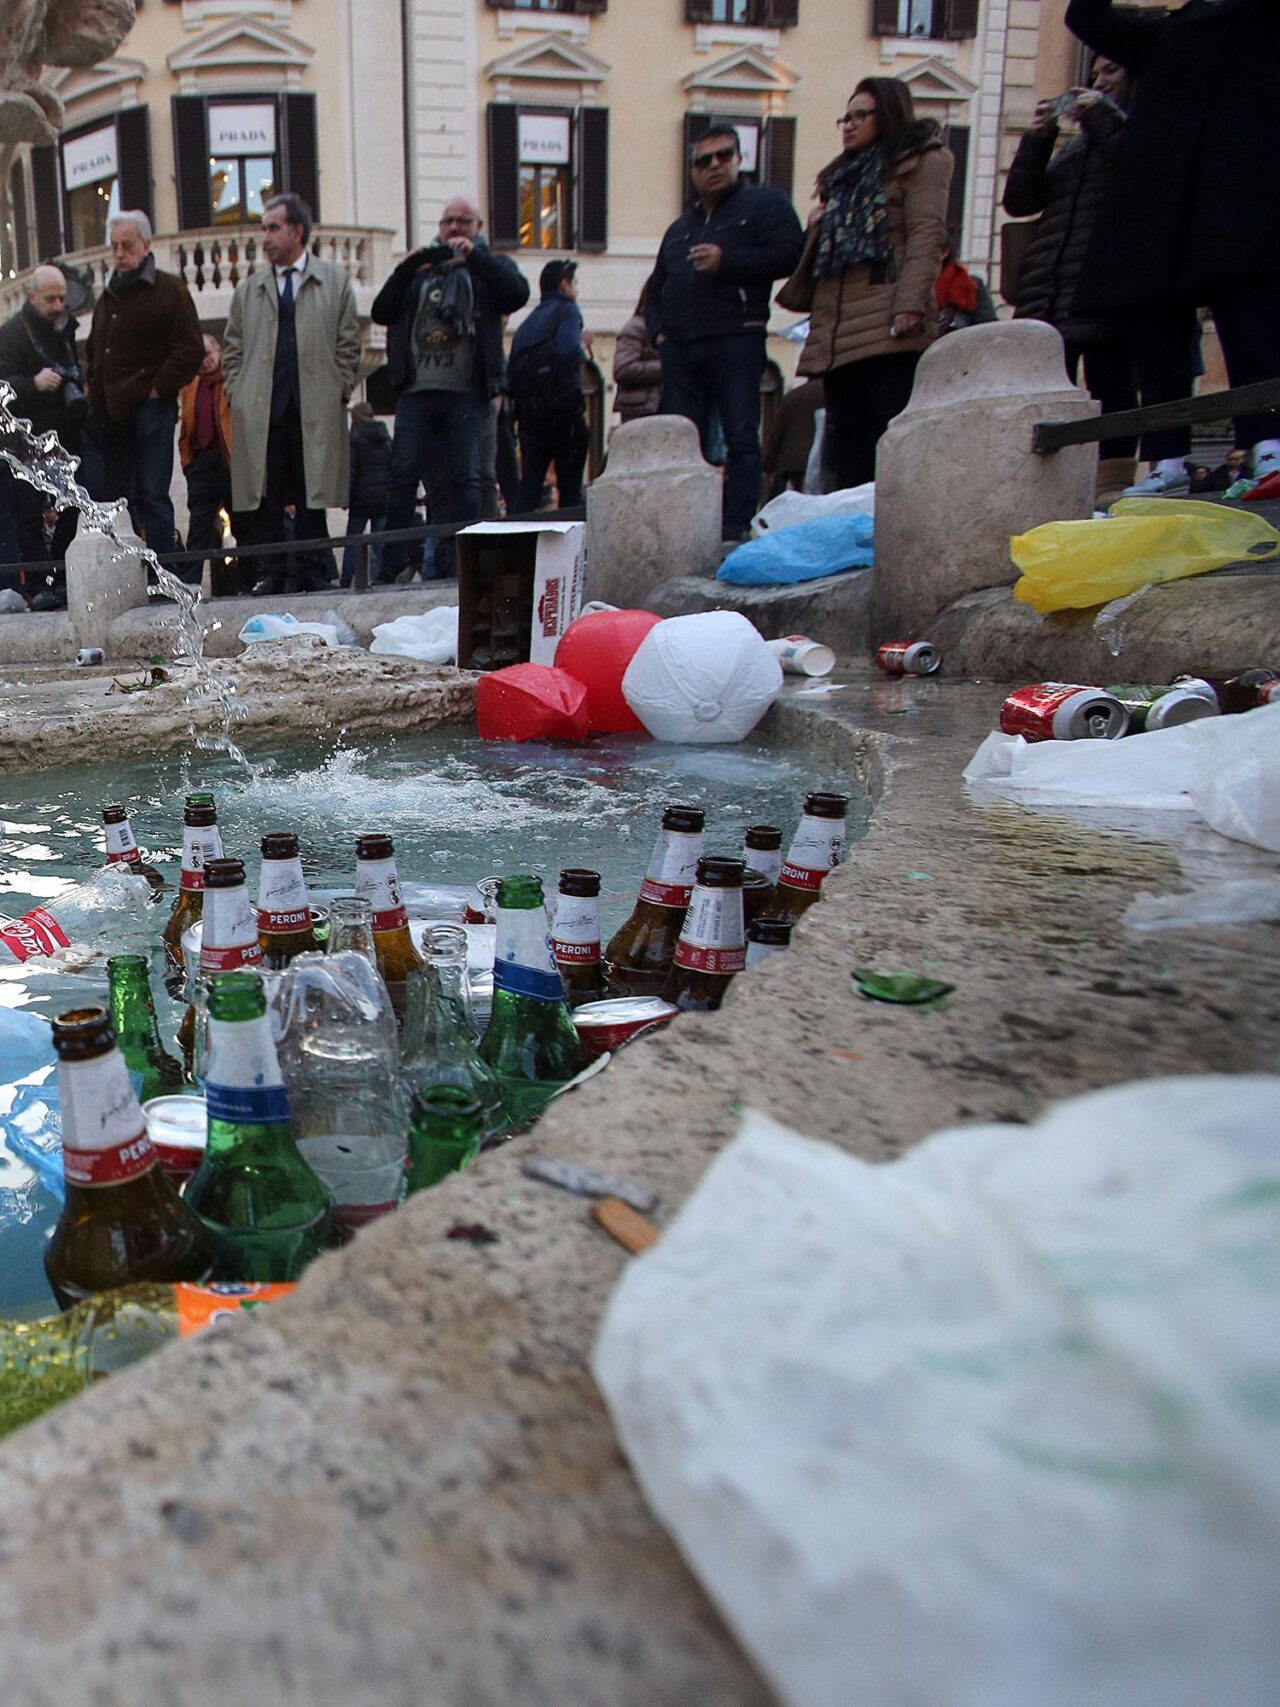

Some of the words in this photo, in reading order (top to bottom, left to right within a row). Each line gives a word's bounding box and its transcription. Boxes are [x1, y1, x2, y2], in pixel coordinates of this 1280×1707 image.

[220, 129, 267, 142] PRADA
[523, 138, 563, 151] PRADA
[73, 152, 112, 176] PRADA
[543, 578, 560, 637] DESPERADOS
[782, 865, 809, 881] ERONI
[269, 912, 306, 925] PERONI
[241, 944, 261, 960] PER
[555, 943, 592, 955] PERONI
[118, 1136, 153, 1166] PER
